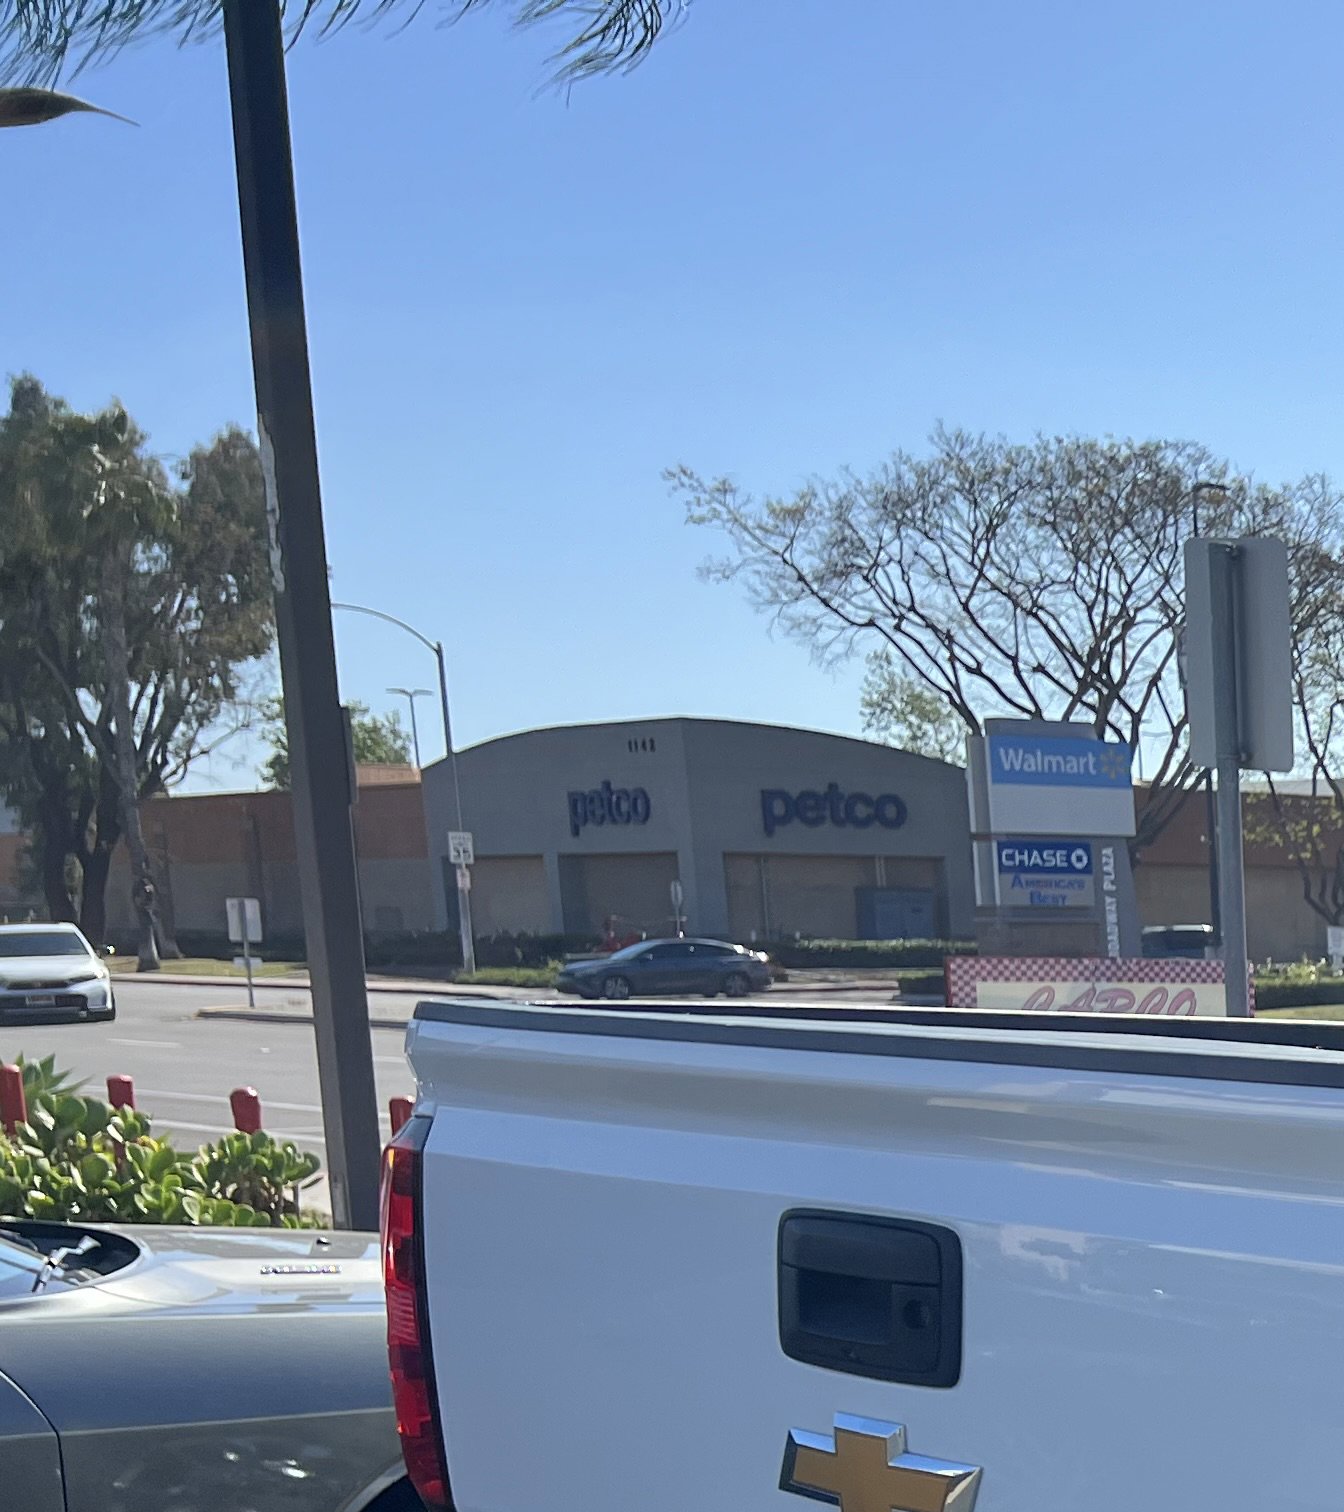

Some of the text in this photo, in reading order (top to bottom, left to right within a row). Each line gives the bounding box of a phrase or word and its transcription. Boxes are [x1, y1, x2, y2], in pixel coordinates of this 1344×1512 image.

[1000, 748, 1097, 775] Walmart
[567, 780, 650, 837] petco
[760, 782, 907, 837] petco
[1001, 848, 1069, 868] CHASE
